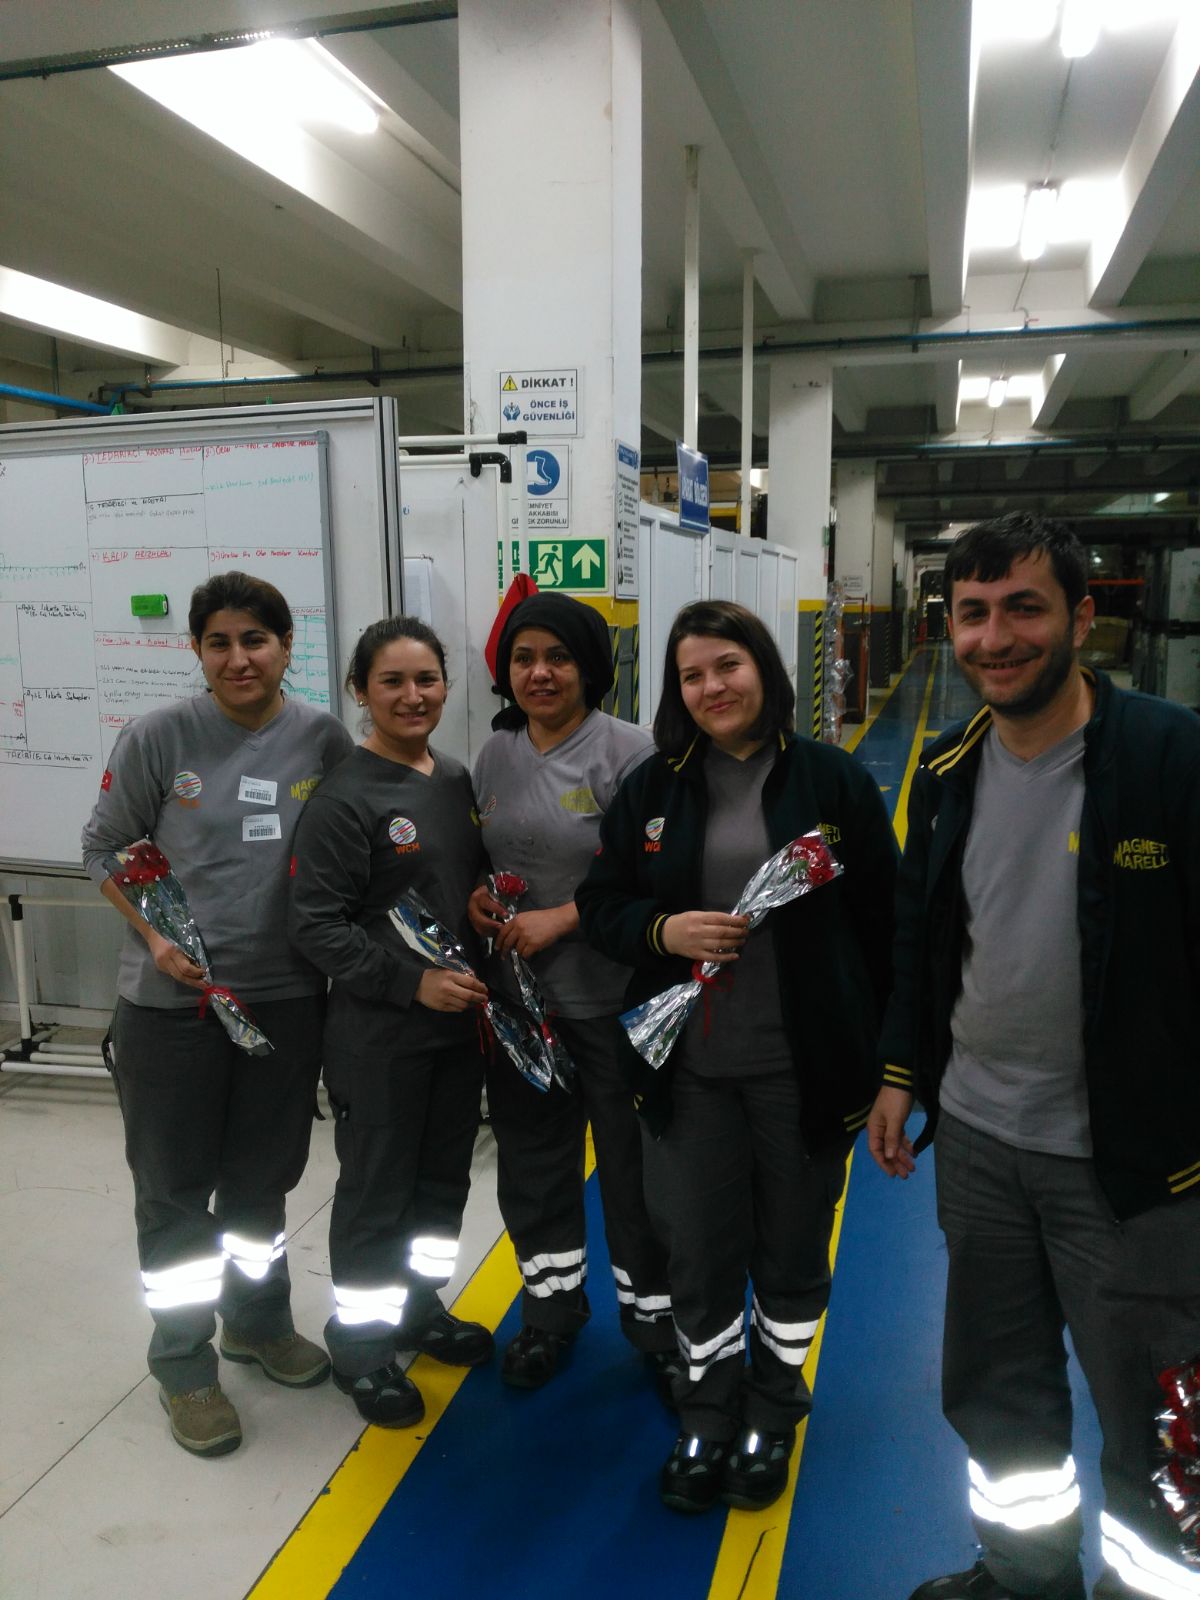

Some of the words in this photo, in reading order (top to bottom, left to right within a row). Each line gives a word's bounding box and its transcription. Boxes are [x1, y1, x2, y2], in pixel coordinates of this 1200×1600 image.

[521, 377, 567, 389] DİKKAT
[530, 399, 557, 409] ÖNCE
[559, 398, 569, 409] İŞ
[522, 411, 575, 421] GÜVENLİĞİ
